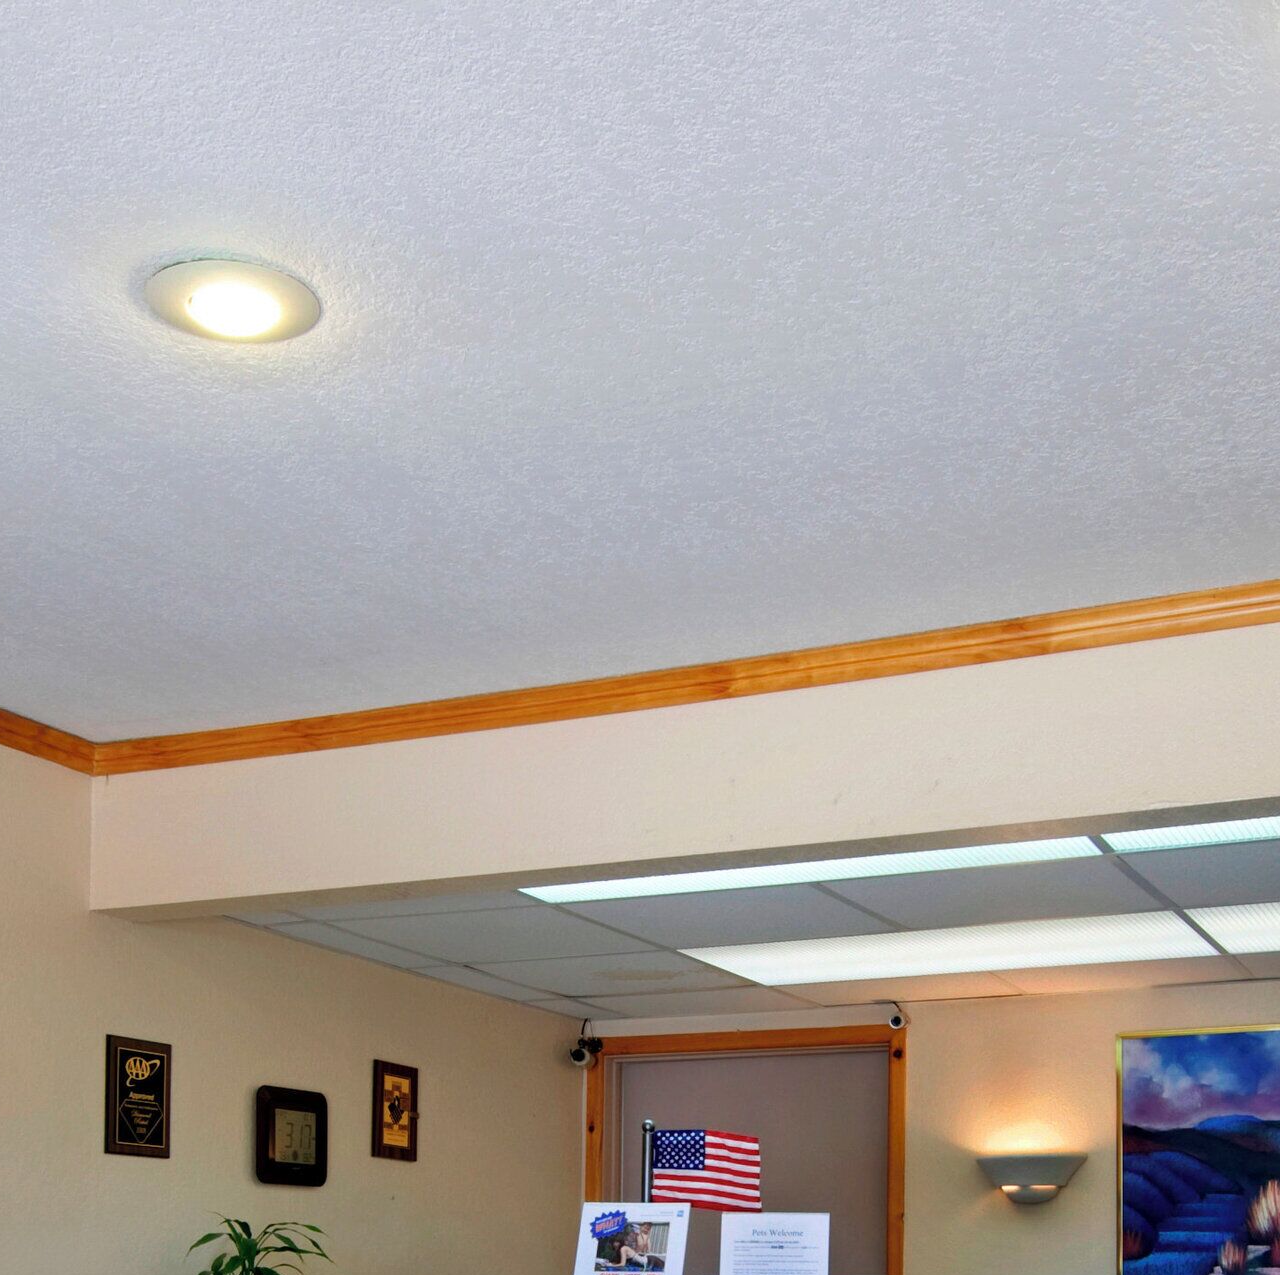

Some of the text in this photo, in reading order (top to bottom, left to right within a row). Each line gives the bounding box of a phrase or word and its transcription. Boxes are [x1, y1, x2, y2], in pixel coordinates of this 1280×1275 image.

[127, 1058, 150, 1079] AAA
[752, 1229, 804, 1238] Pets Welcome
